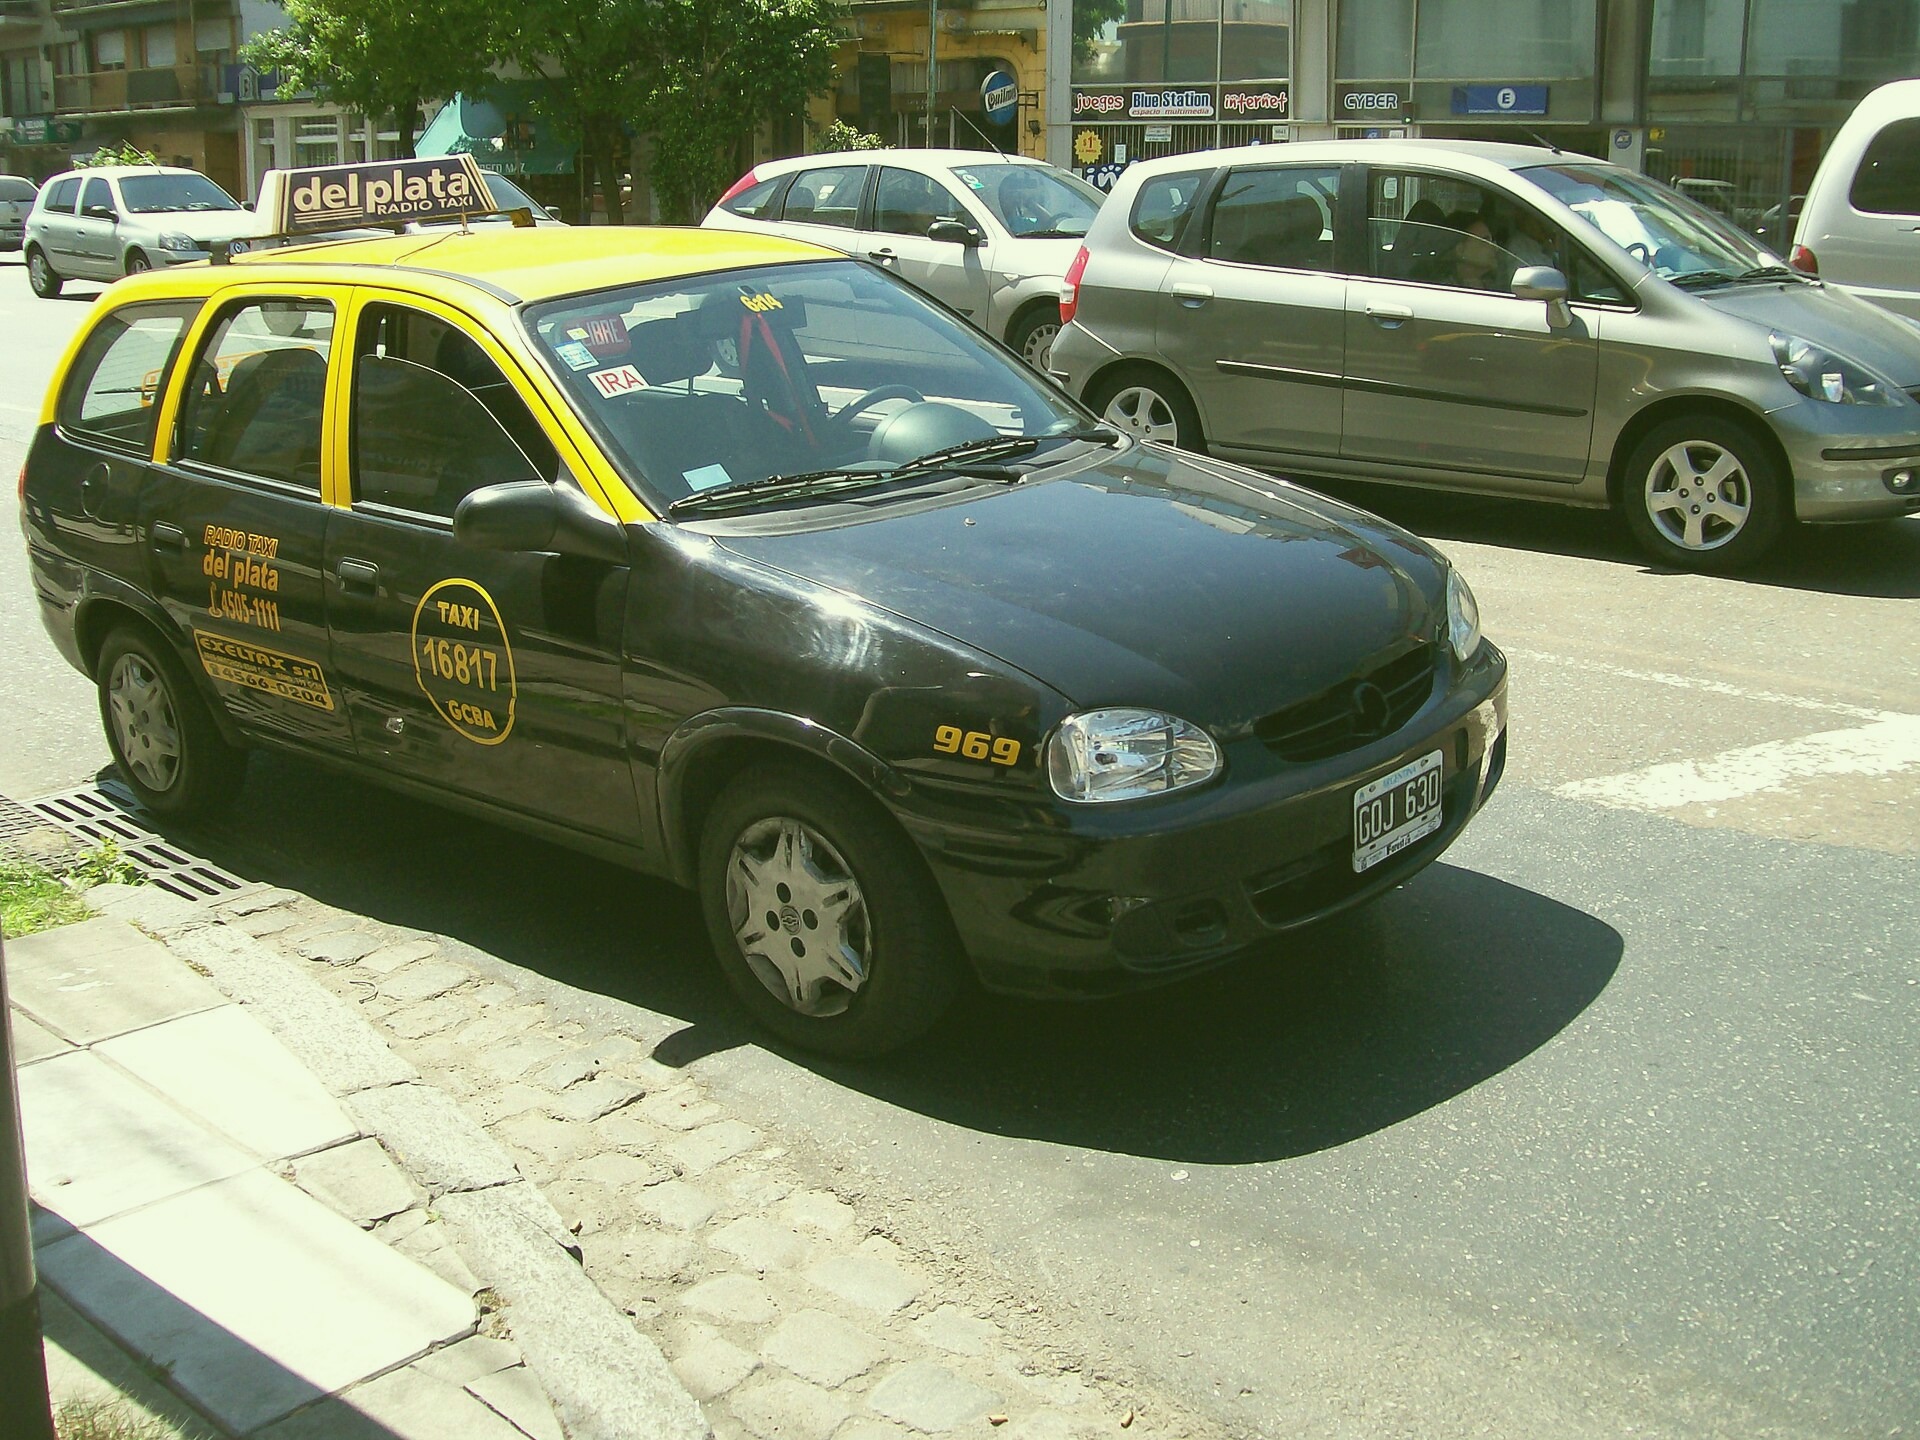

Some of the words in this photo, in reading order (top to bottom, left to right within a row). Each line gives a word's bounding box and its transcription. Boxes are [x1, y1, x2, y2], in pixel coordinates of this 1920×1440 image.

[1074, 93, 1124, 113] juegos
[1132, 108, 1160, 116] espacio
[1165, 107, 1210, 115] multimedia
[1133, 92, 1160, 108] Blue
[1162, 91, 1210, 108] Station
[1225, 92, 1287, 114] internet
[1344, 92, 1398, 109] CYBER
[1502, 92, 1511, 104] E
[293, 173, 359, 212] del
[365, 167, 470, 214] plata
[377, 199, 433, 216] RADIO
[438, 195, 474, 209] TAXI
[596, 369, 645, 394] IRA
[204, 525, 246, 552] RADIO
[248, 533, 279, 559] TAXI
[203, 548, 231, 579] del
[233, 556, 279, 592] plata
[221, 590, 281, 632] 4505-1111
[437, 600, 480, 632] TAXI
[199, 635, 287, 672] EXELTAX
[293, 664, 320, 682] srl
[423, 637, 497, 692] 16817
[223, 667, 328, 707] 4566-0204
[448, 699, 498, 731] GCBA
[933, 725, 1021, 766] 969
[1359, 792, 1395, 845] GOJ
[1405, 769, 1439, 820] 630
